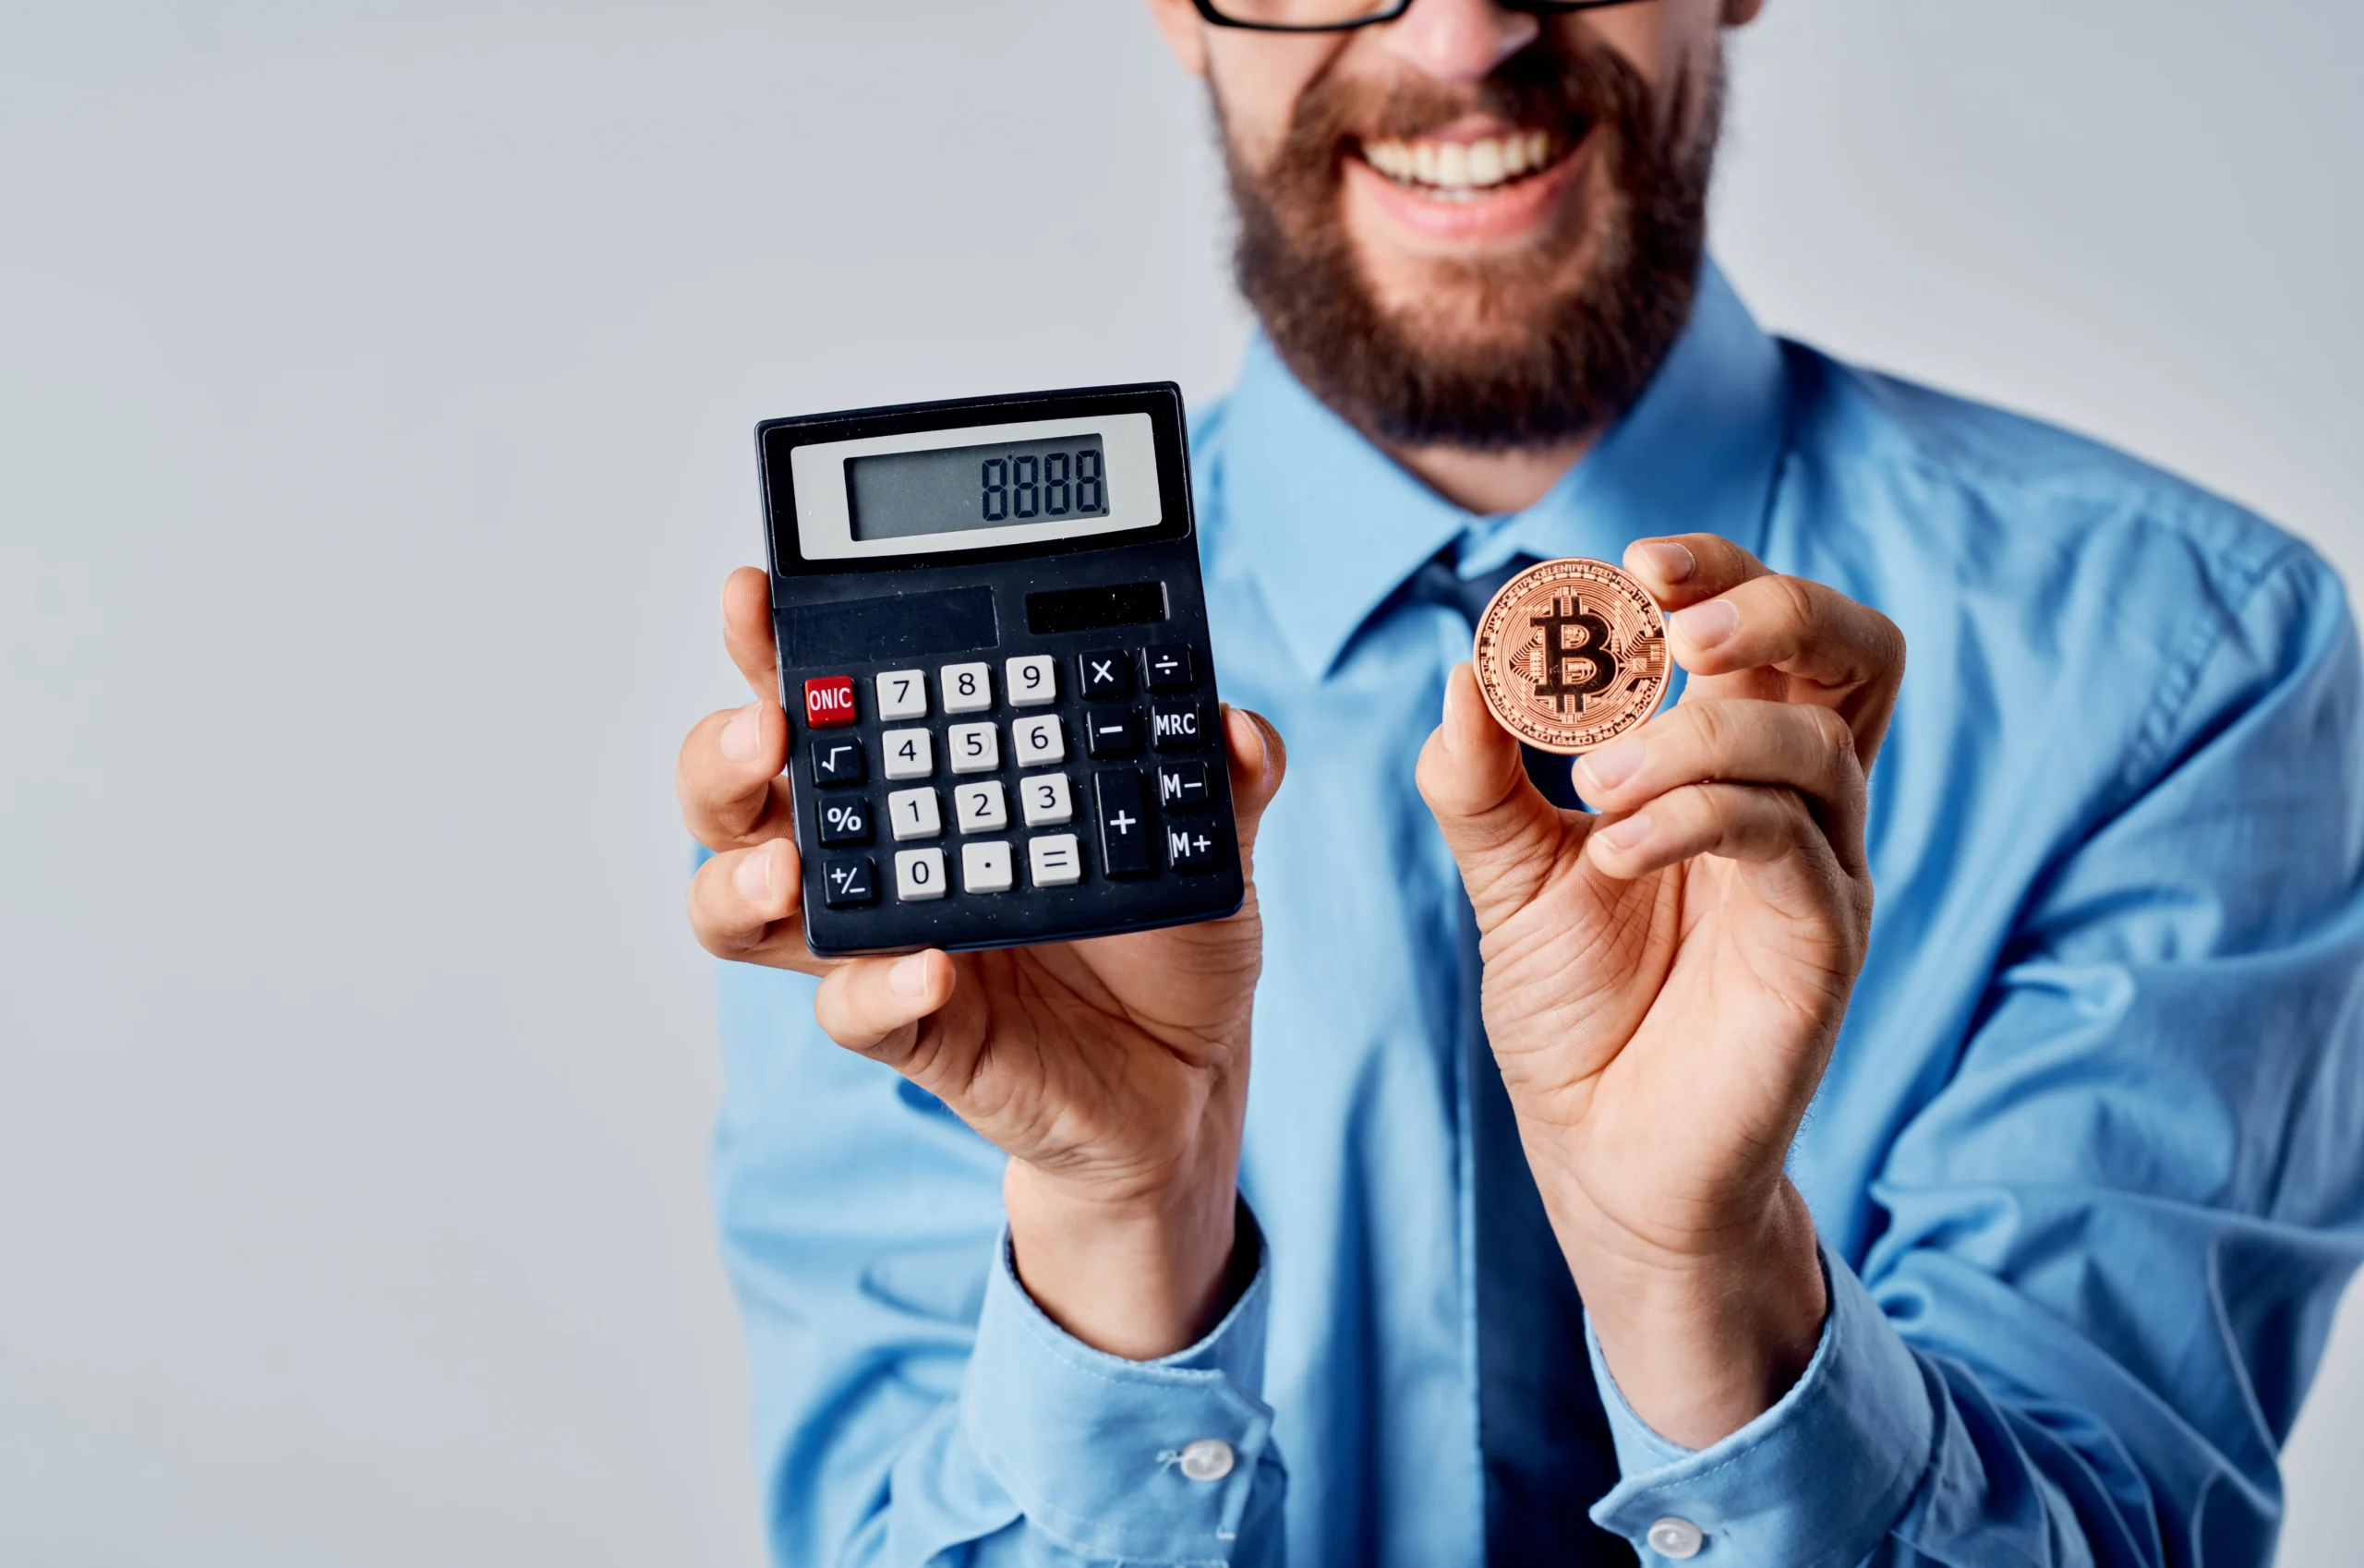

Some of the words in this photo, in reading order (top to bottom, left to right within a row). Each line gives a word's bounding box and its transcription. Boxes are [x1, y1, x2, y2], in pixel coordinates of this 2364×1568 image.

[959, 672, 976, 695] 8
[1022, 666, 1041, 688] 9
[893, 680, 910, 703] 7
[1156, 713, 1196, 736] MRC
[967, 732, 983, 755] 5
[1031, 726, 1049, 749] 6
[899, 740, 917, 762] 4
[972, 793, 991, 817] 2
[1038, 786, 1056, 809] 3
[827, 806, 862, 832] %
[908, 800, 920, 823] 1
[1171, 832, 1212, 859] M+
[911, 861, 929, 885] 0
